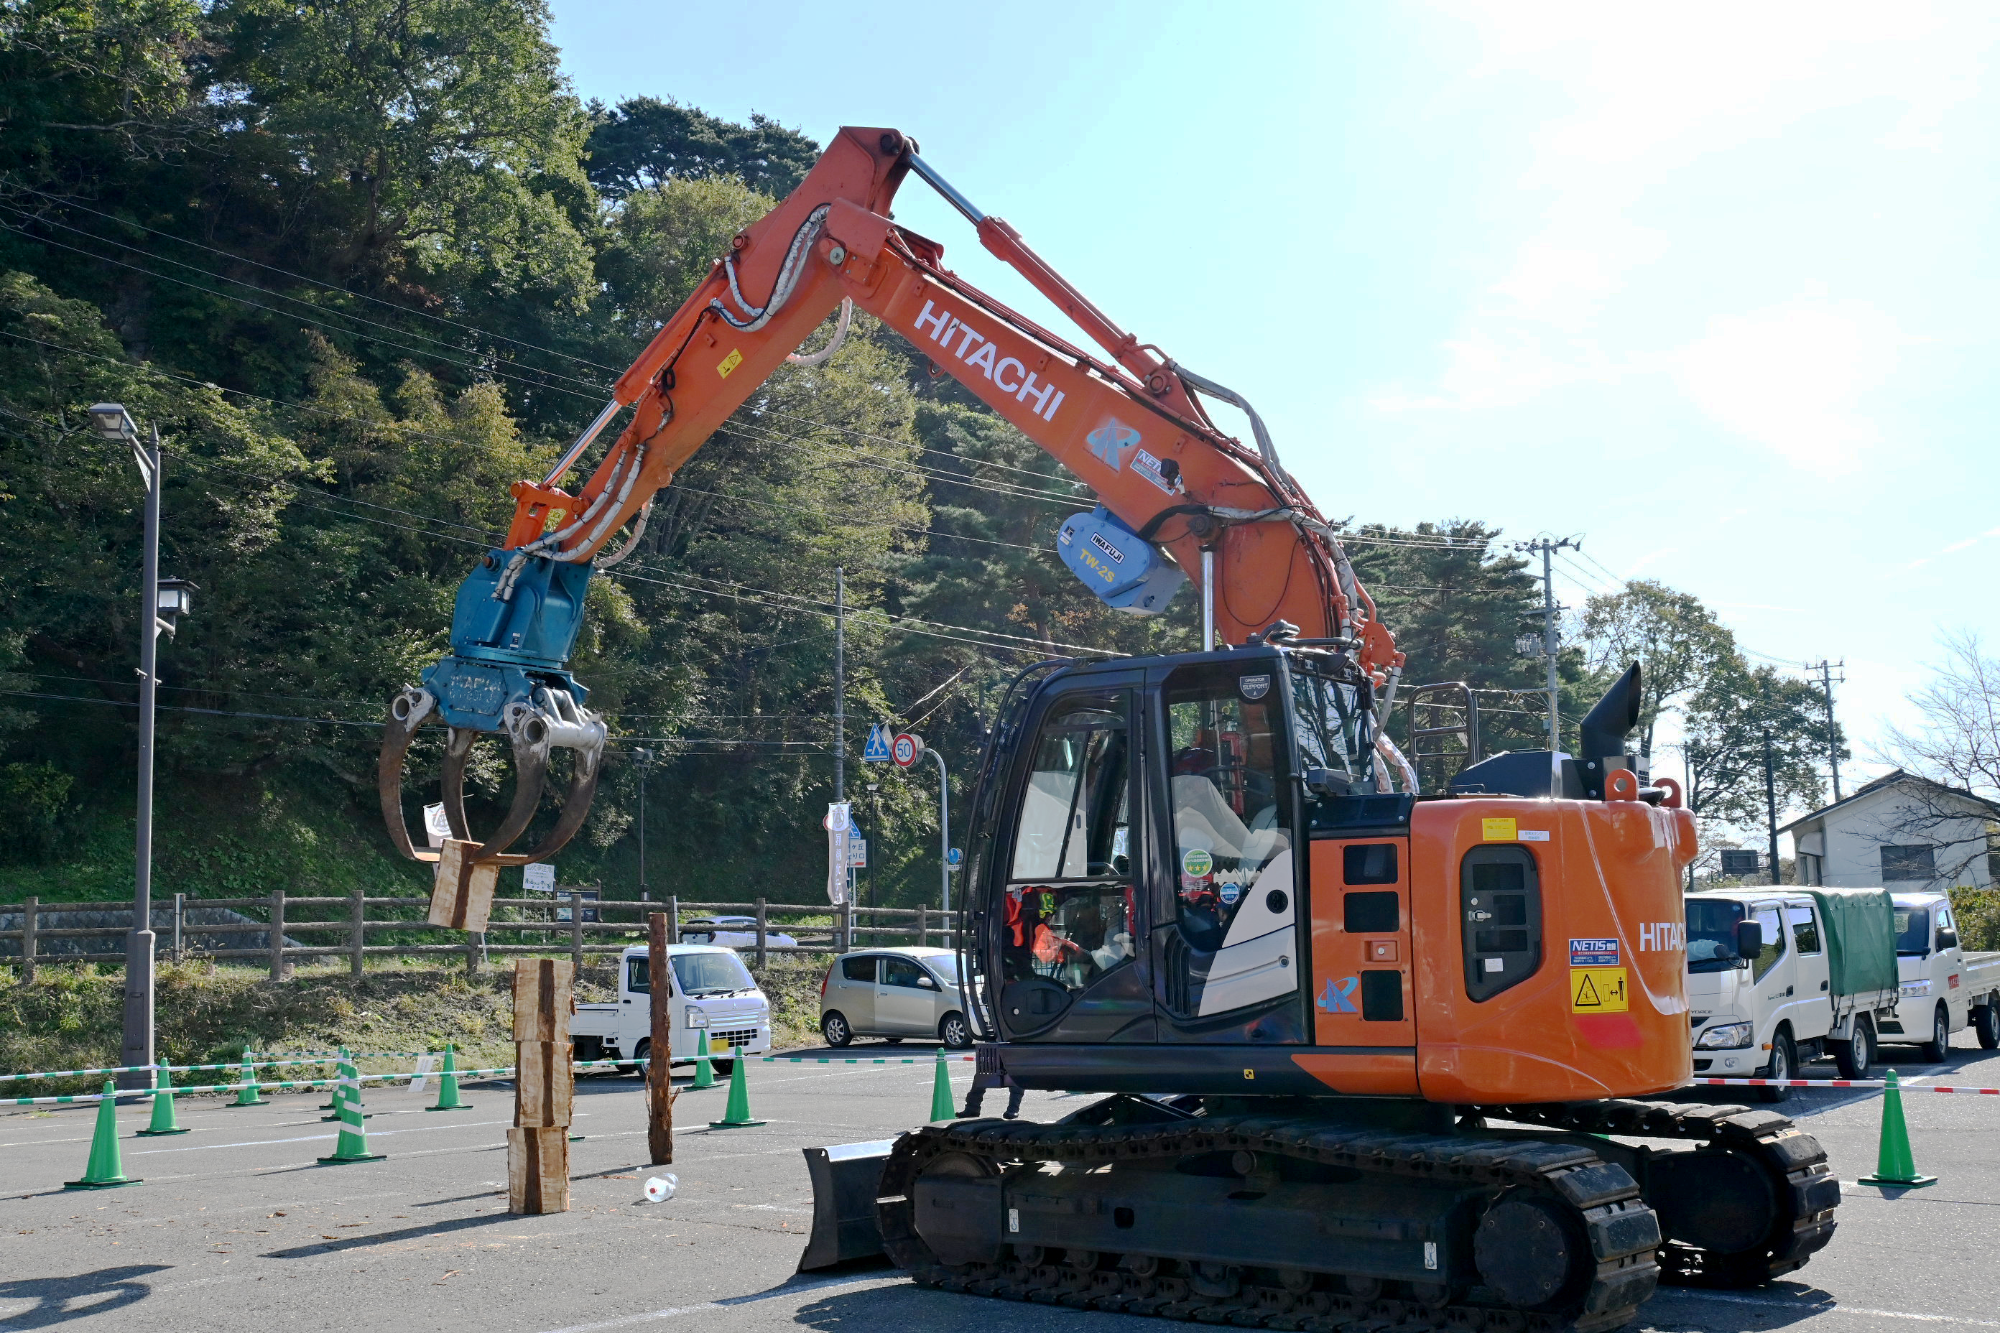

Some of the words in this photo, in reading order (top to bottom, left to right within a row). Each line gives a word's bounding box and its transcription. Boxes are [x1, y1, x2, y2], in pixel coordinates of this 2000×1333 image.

[913, 299, 1066, 422] HITACHI
[1092, 534, 1123, 562] IWAFUJI
[1079, 548, 1116, 583] TW-2S
[897, 744, 911, 758] 50
[1572, 940, 1606, 951] NETIS
